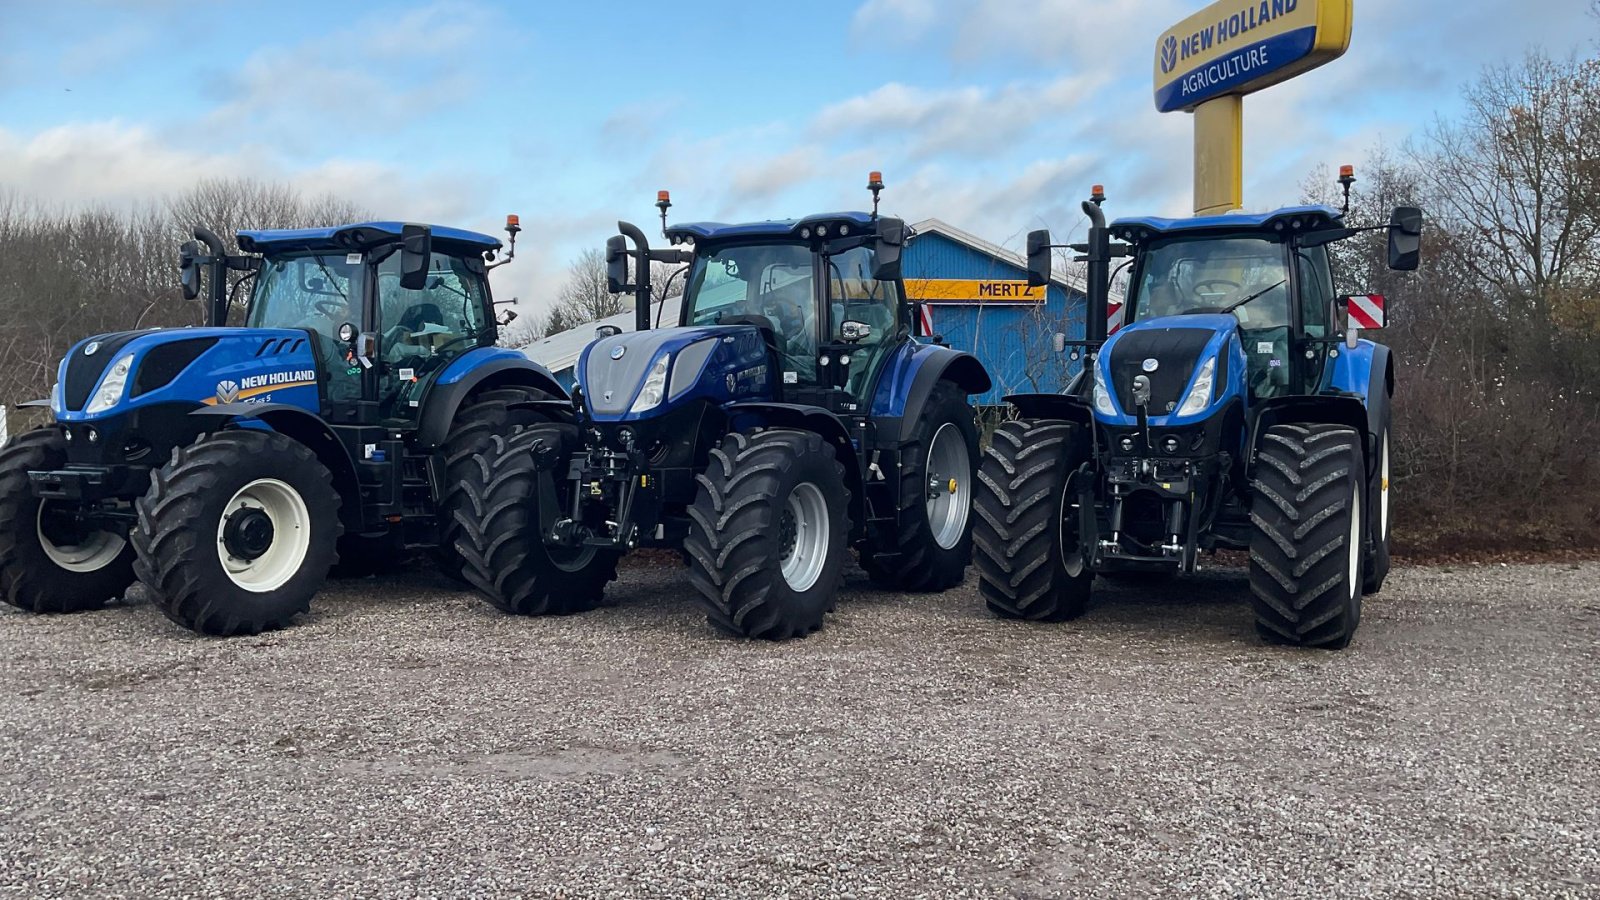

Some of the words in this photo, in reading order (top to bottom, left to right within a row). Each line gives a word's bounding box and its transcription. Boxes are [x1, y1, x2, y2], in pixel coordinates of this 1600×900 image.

[1181, 26, 1214, 60] NEW
[1218, 0, 1297, 44] HOLLAND
[1182, 45, 1268, 96] AGRICULTURE
[979, 283, 1034, 296] MERTZ
[242, 375, 268, 389] NEW
[270, 370, 315, 383] HOLLAND
